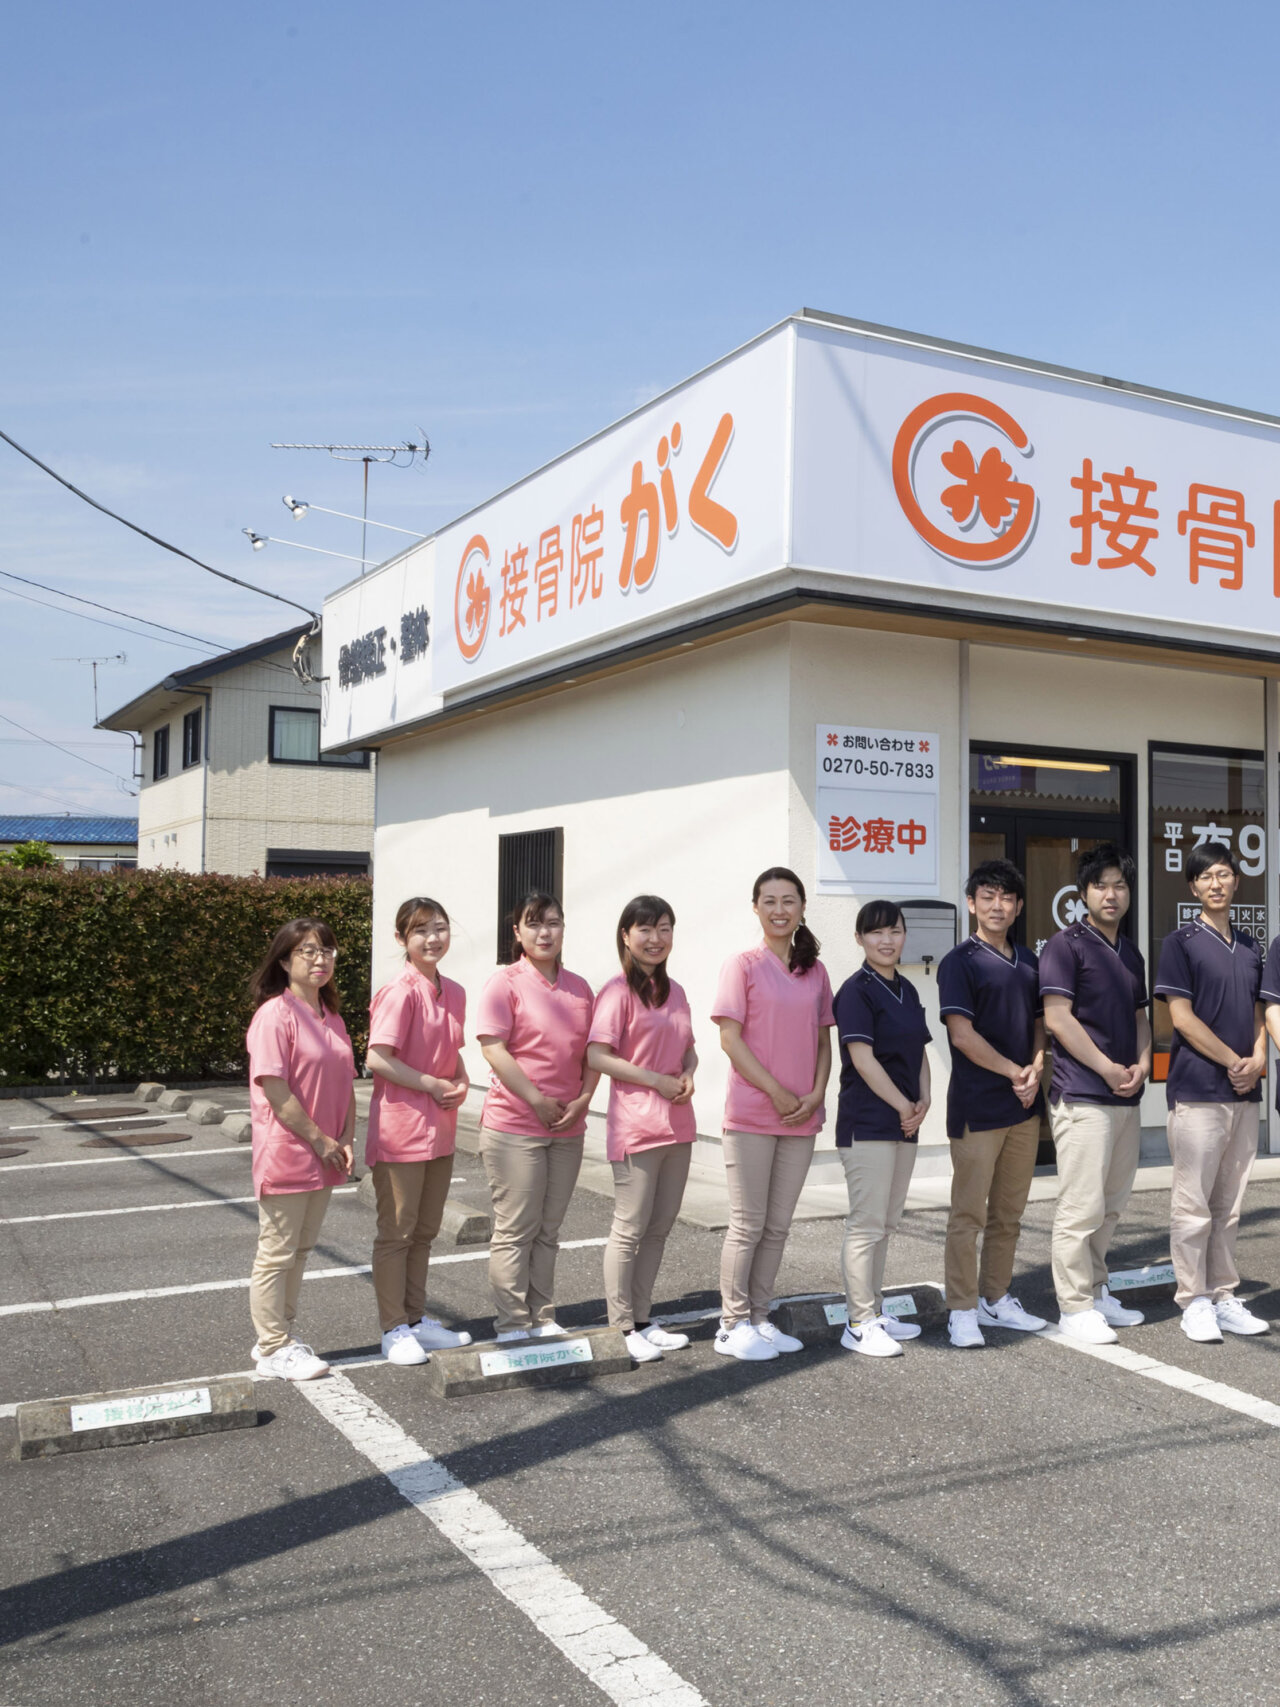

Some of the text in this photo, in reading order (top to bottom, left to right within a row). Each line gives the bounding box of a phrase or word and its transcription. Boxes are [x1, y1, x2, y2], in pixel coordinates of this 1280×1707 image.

[499, 412, 739, 638] 接骨院 がく
[843, 735, 915, 752] お問い合わせ
[823, 757, 934, 779] 0270-50-7833
[828, 815, 927, 855] 診療中
[1164, 822, 1184, 872] 平日
